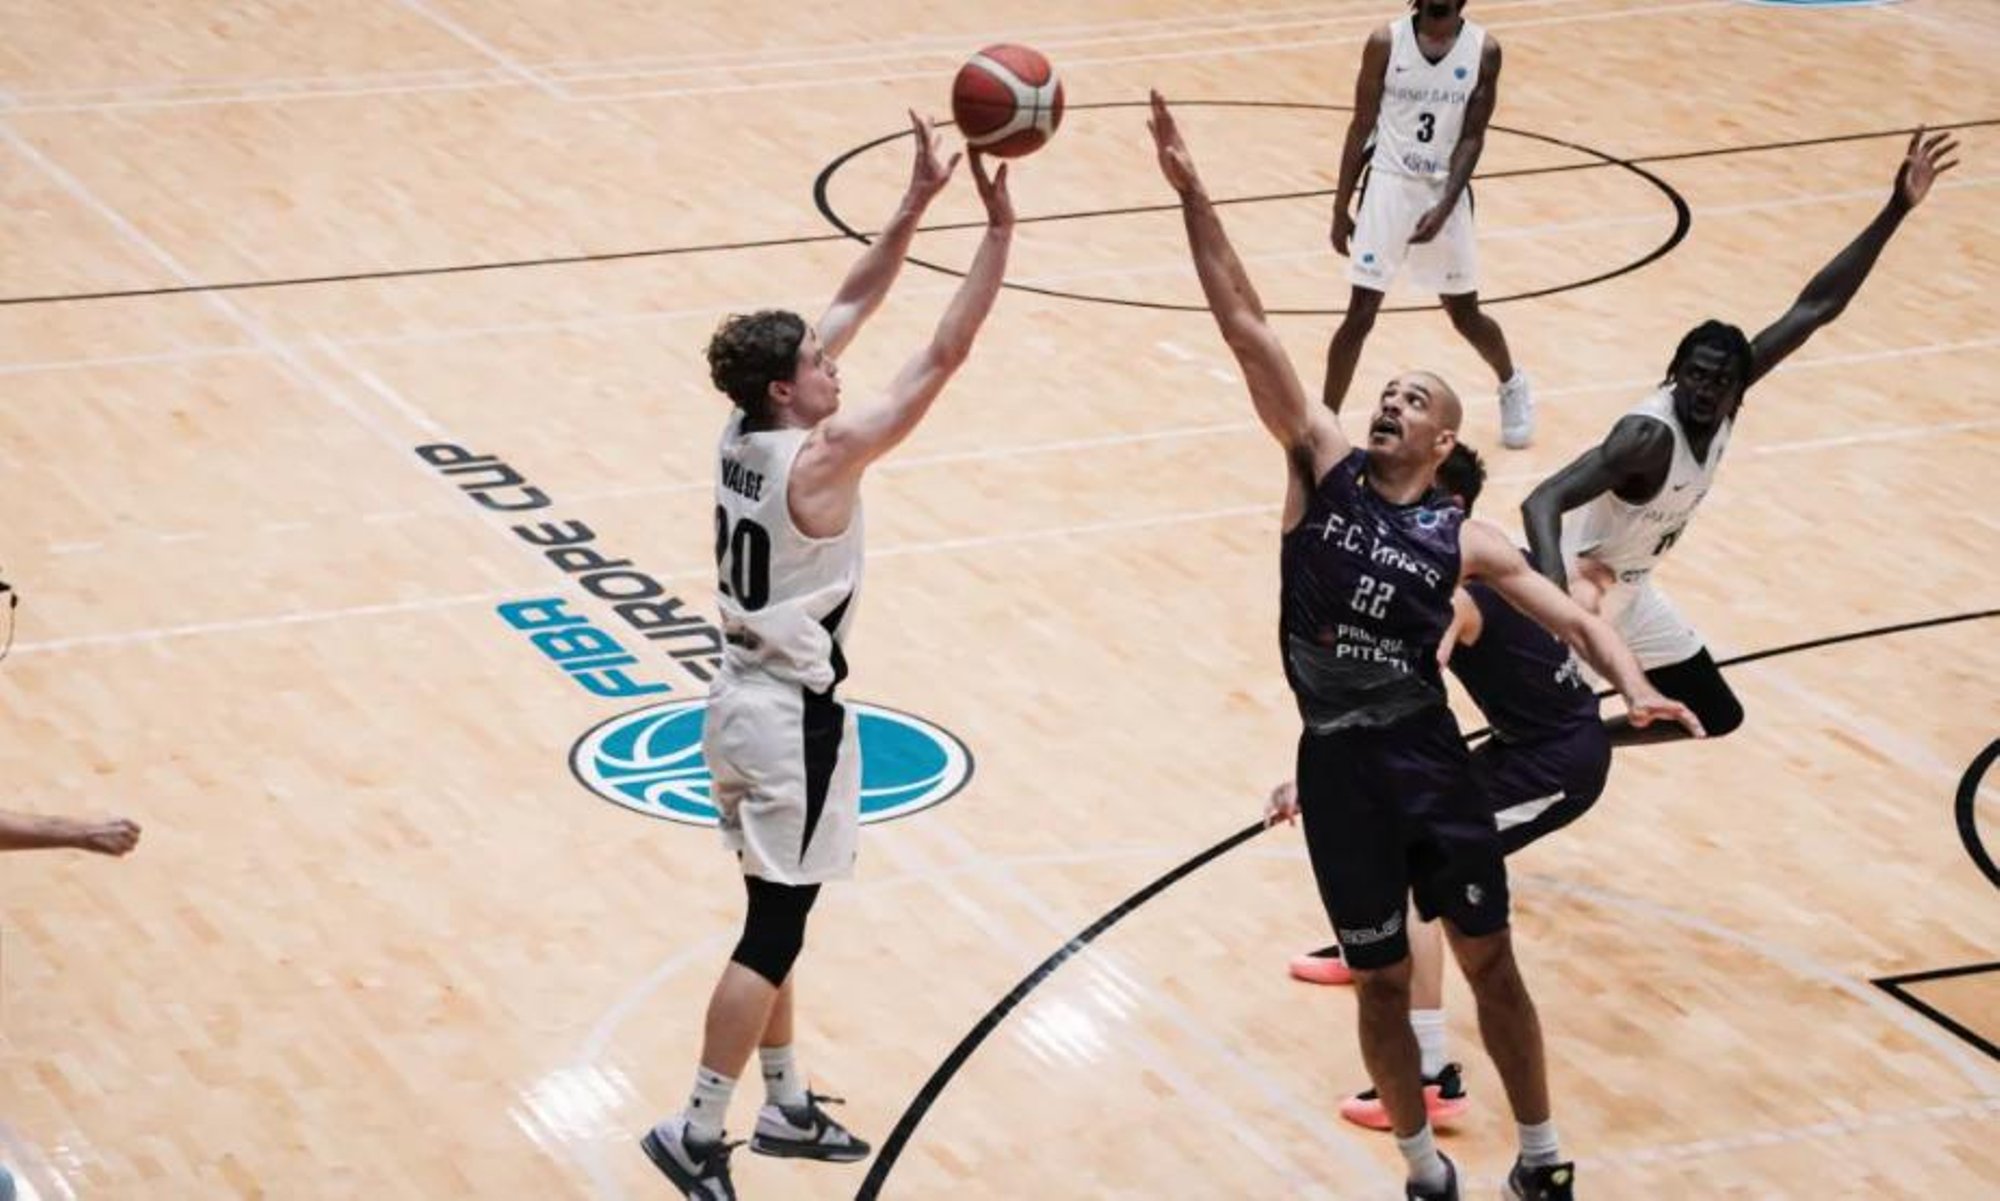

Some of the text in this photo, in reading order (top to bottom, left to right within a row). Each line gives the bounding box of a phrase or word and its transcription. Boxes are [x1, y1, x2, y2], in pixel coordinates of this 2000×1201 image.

[1417, 112, 1435, 143] 3
[414, 444, 553, 511] CUP
[1350, 573, 1396, 620] 22
[495, 597, 674, 698] FIBA
